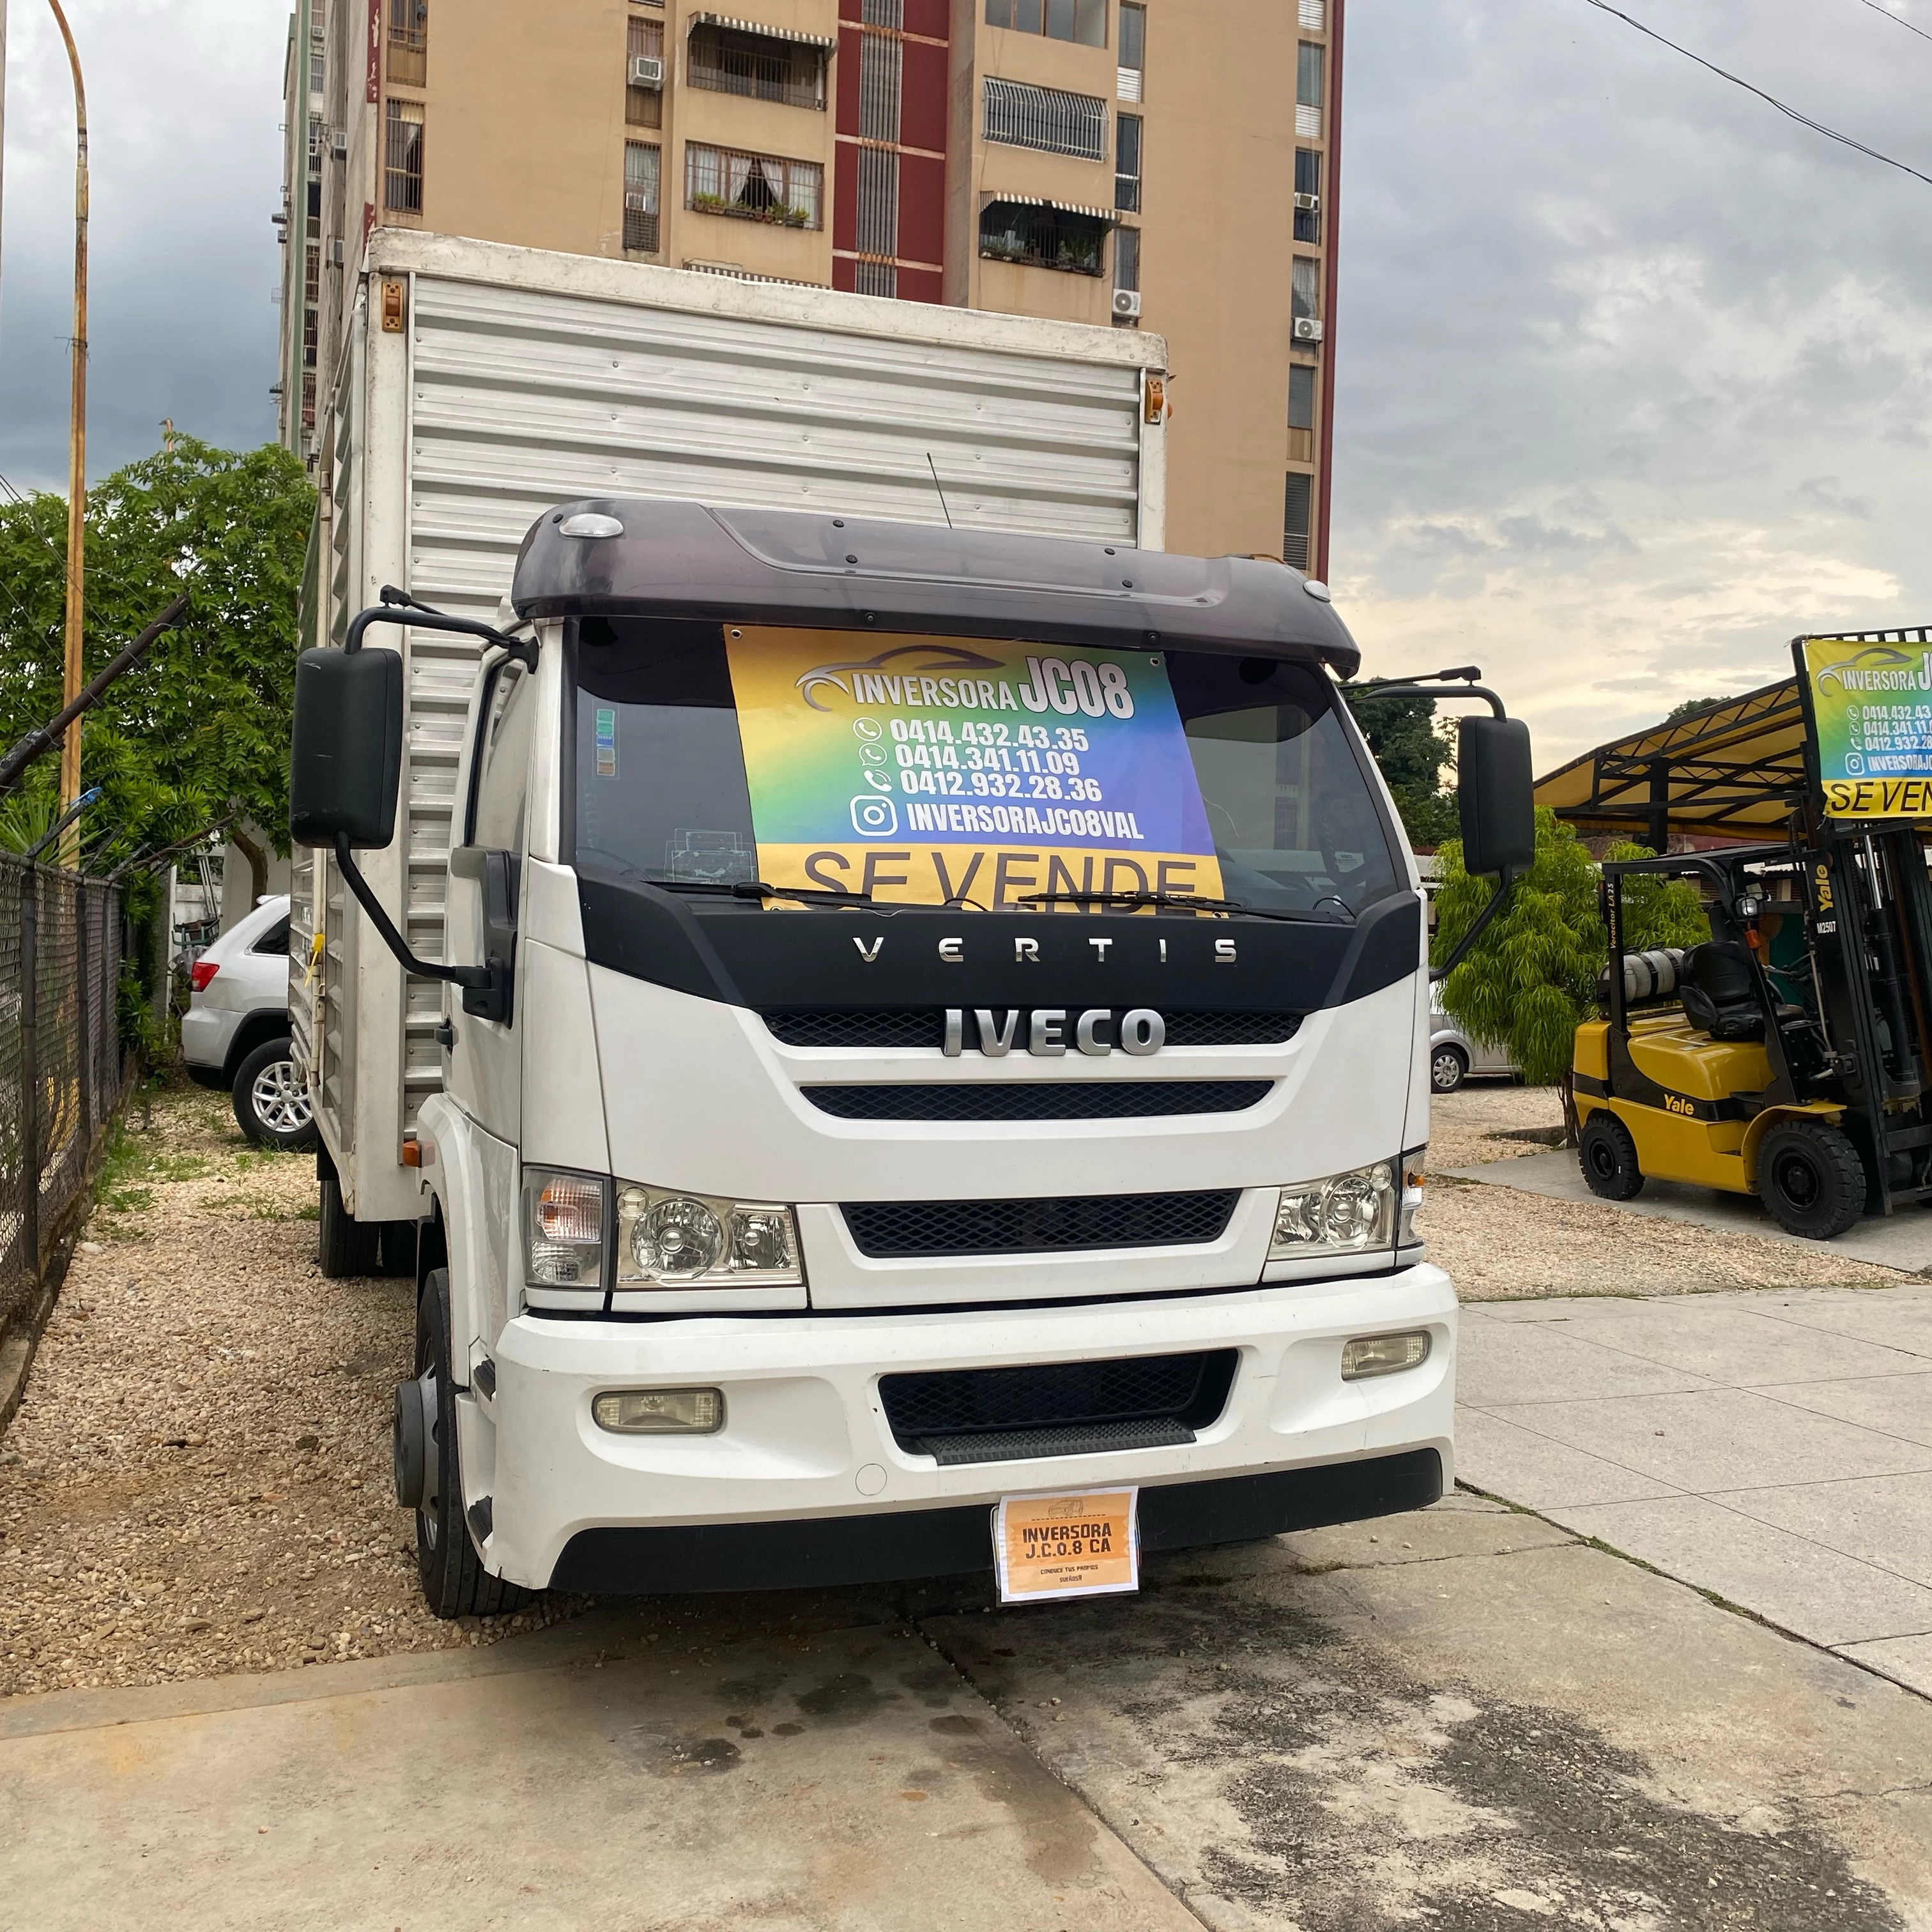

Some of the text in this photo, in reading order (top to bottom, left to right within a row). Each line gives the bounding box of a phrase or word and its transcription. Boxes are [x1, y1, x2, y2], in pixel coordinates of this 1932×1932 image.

[1842, 651, 1932, 691] INVERSORA J
[852, 673, 1020, 712] INVERSORA
[890, 718, 1089, 753] 0414.432.43.35
[894, 744, 1080, 776] 0414.341.11.09
[900, 770, 1103, 802] 0412.932.28.36
[1830, 782, 1874, 811] SE
[931, 852, 1197, 916] VENDE
[1815, 864, 1834, 912] Yale
[1816, 921, 1836, 934] M2507
[853, 937, 1237, 963] VERTIS
[942, 1009, 1165, 1057] IVECO
[1664, 1094, 1694, 1115] Yale
[1023, 1522, 1112, 1544] INVERSORA
[1089, 1537, 1111, 1554] CA
